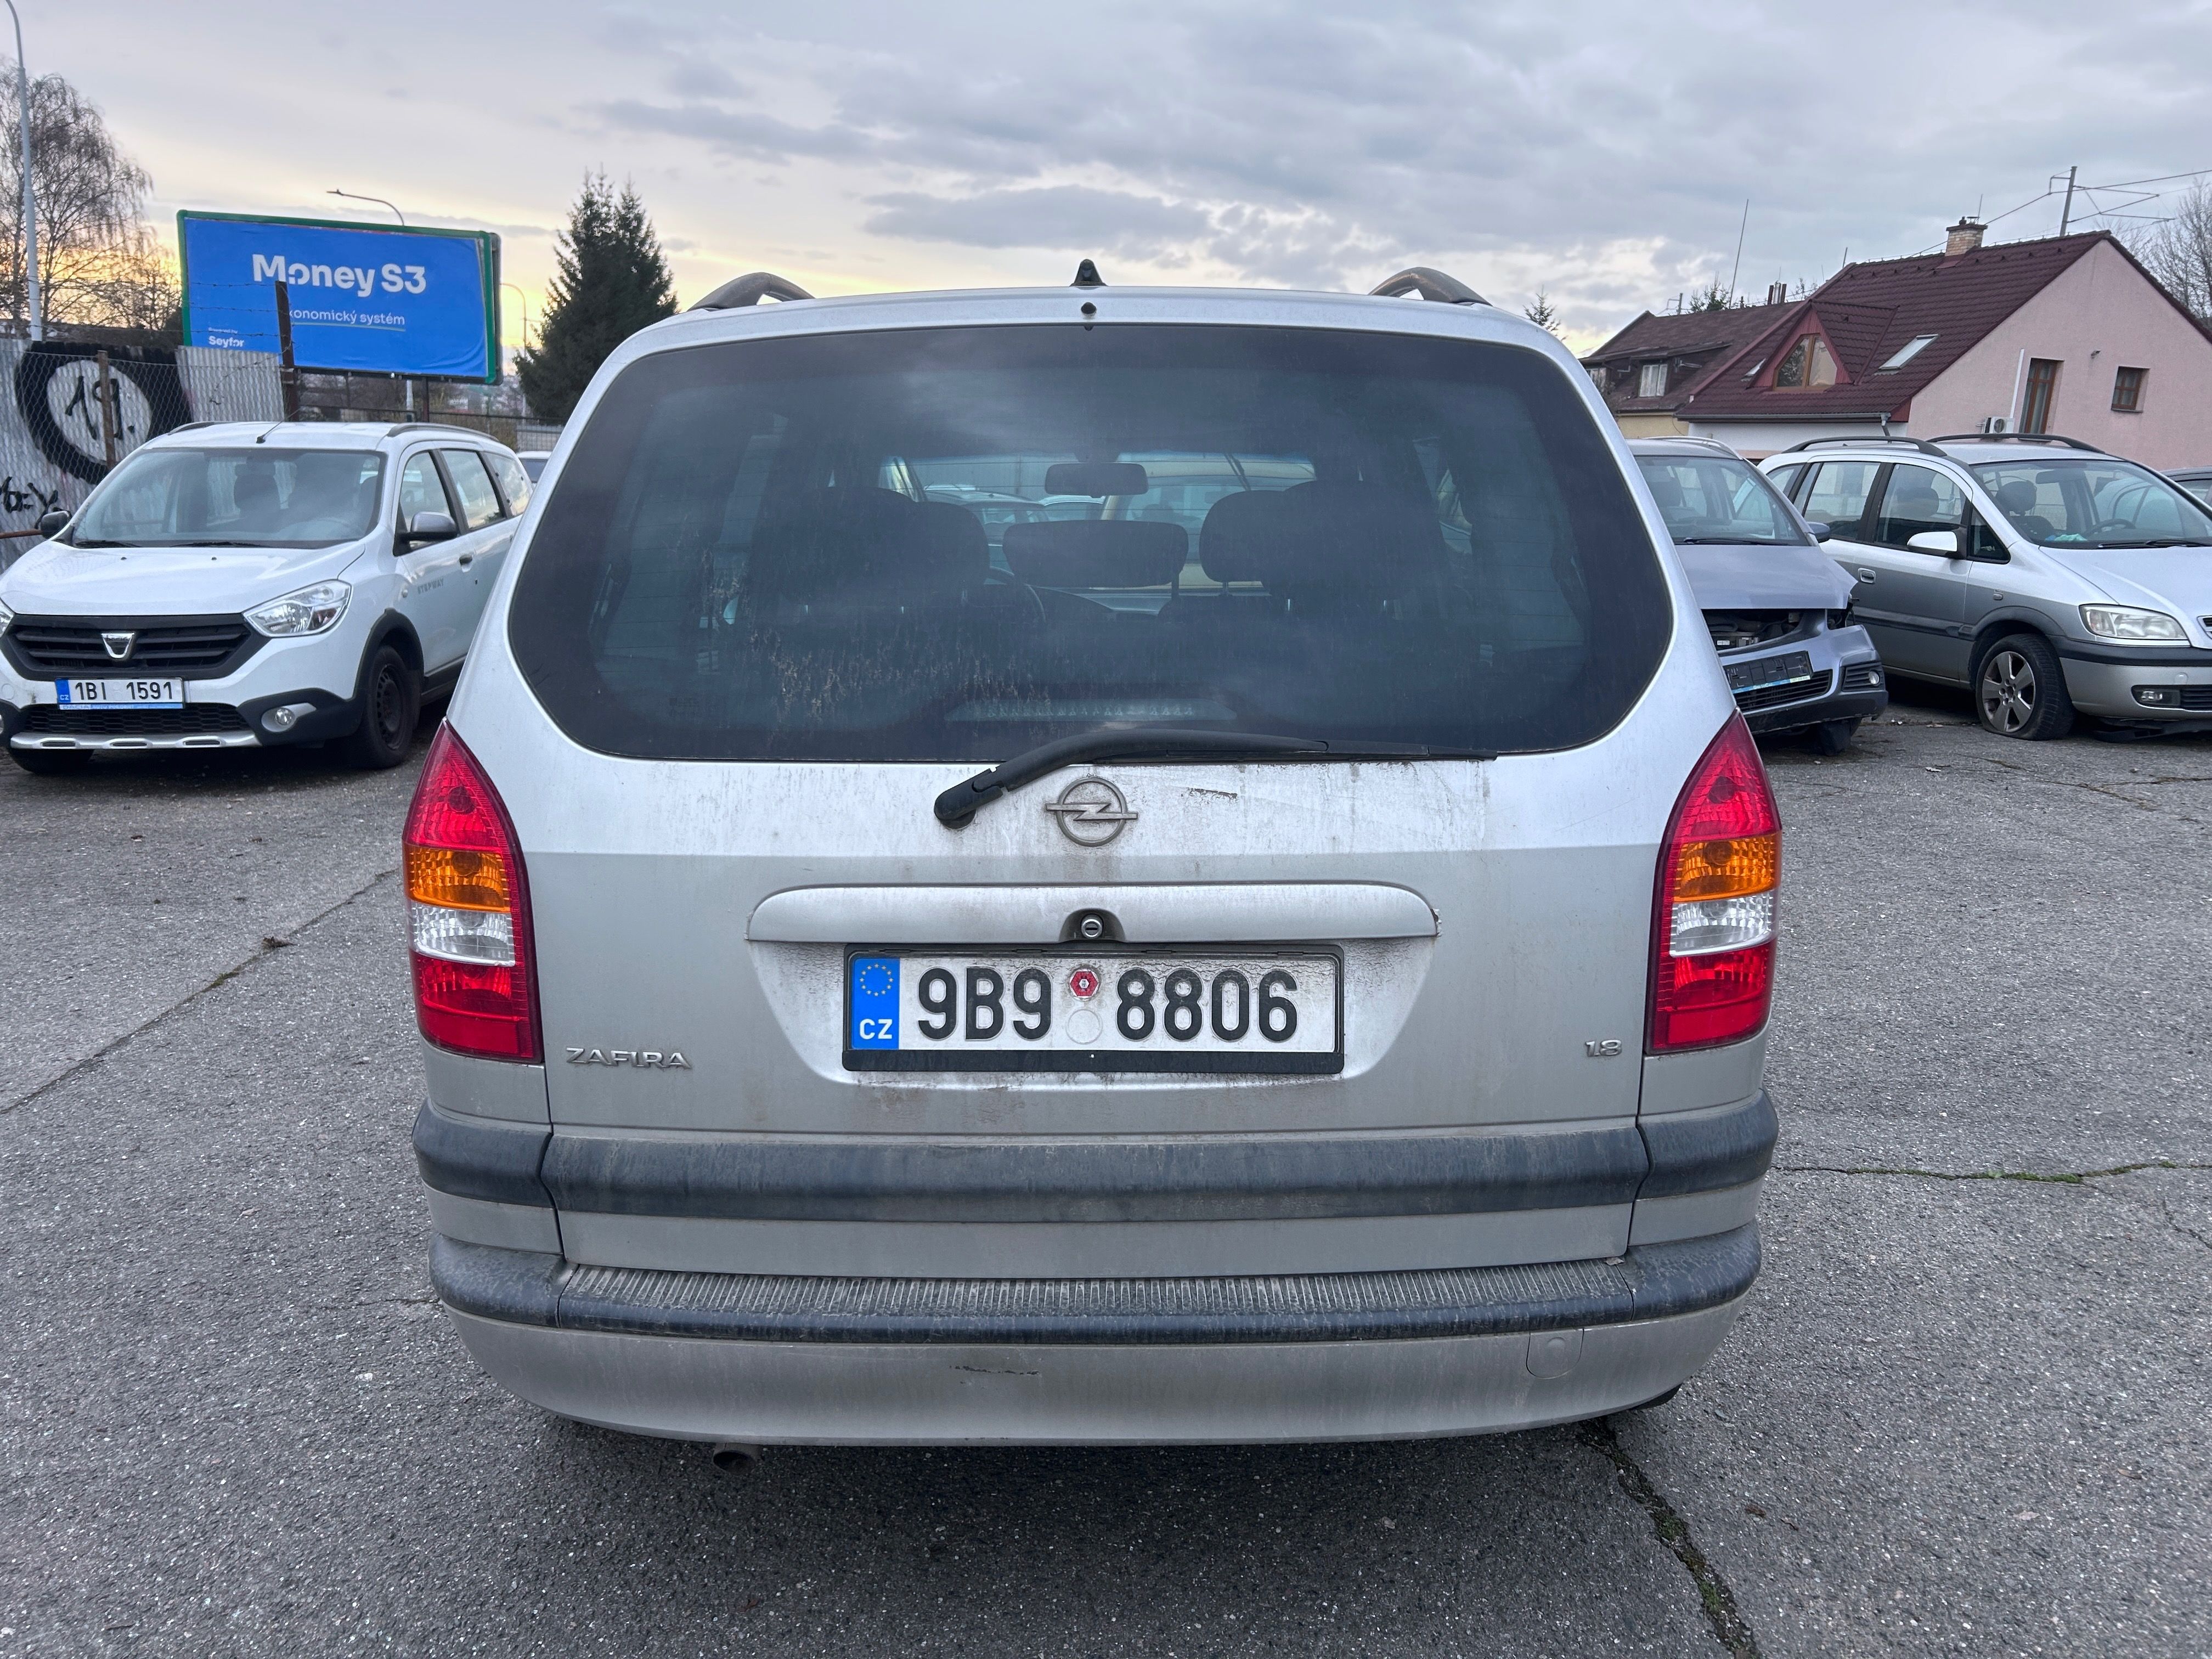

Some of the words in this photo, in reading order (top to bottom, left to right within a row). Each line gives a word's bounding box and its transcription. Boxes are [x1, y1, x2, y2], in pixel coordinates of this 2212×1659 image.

[252, 253, 376, 298] Money
[381, 263, 427, 295] S3
[289, 309, 357, 325] konomický
[359, 312, 405, 325] systém
[126, 681, 173, 700] 1591
[917, 968, 1053, 1041] 9B9
[1116, 968, 1298, 1043] 8806
[859, 1018, 893, 1040] CZ
[566, 1047, 692, 1070] ZAFIRA
